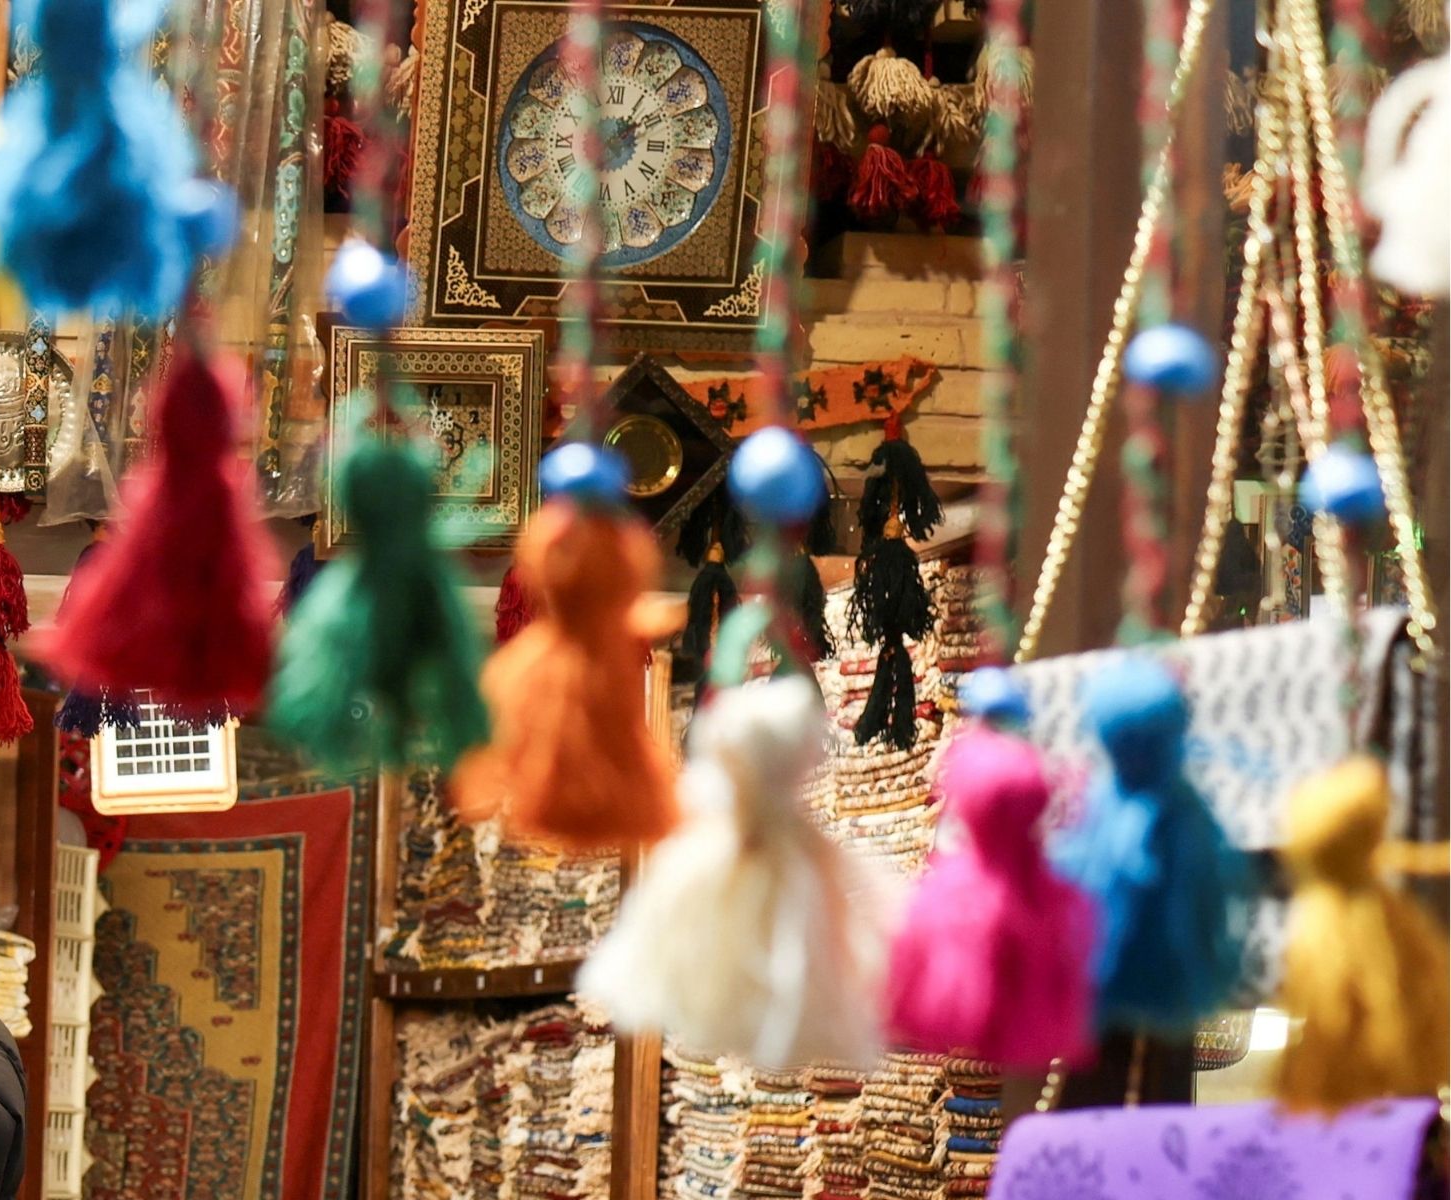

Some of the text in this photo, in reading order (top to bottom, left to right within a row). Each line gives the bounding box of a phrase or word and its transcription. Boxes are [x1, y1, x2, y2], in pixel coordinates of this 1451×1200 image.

[606, 85, 625, 105] XII
[647, 140, 665, 152] III
[638, 160, 656, 181] IV
[624, 179, 636, 197] V
